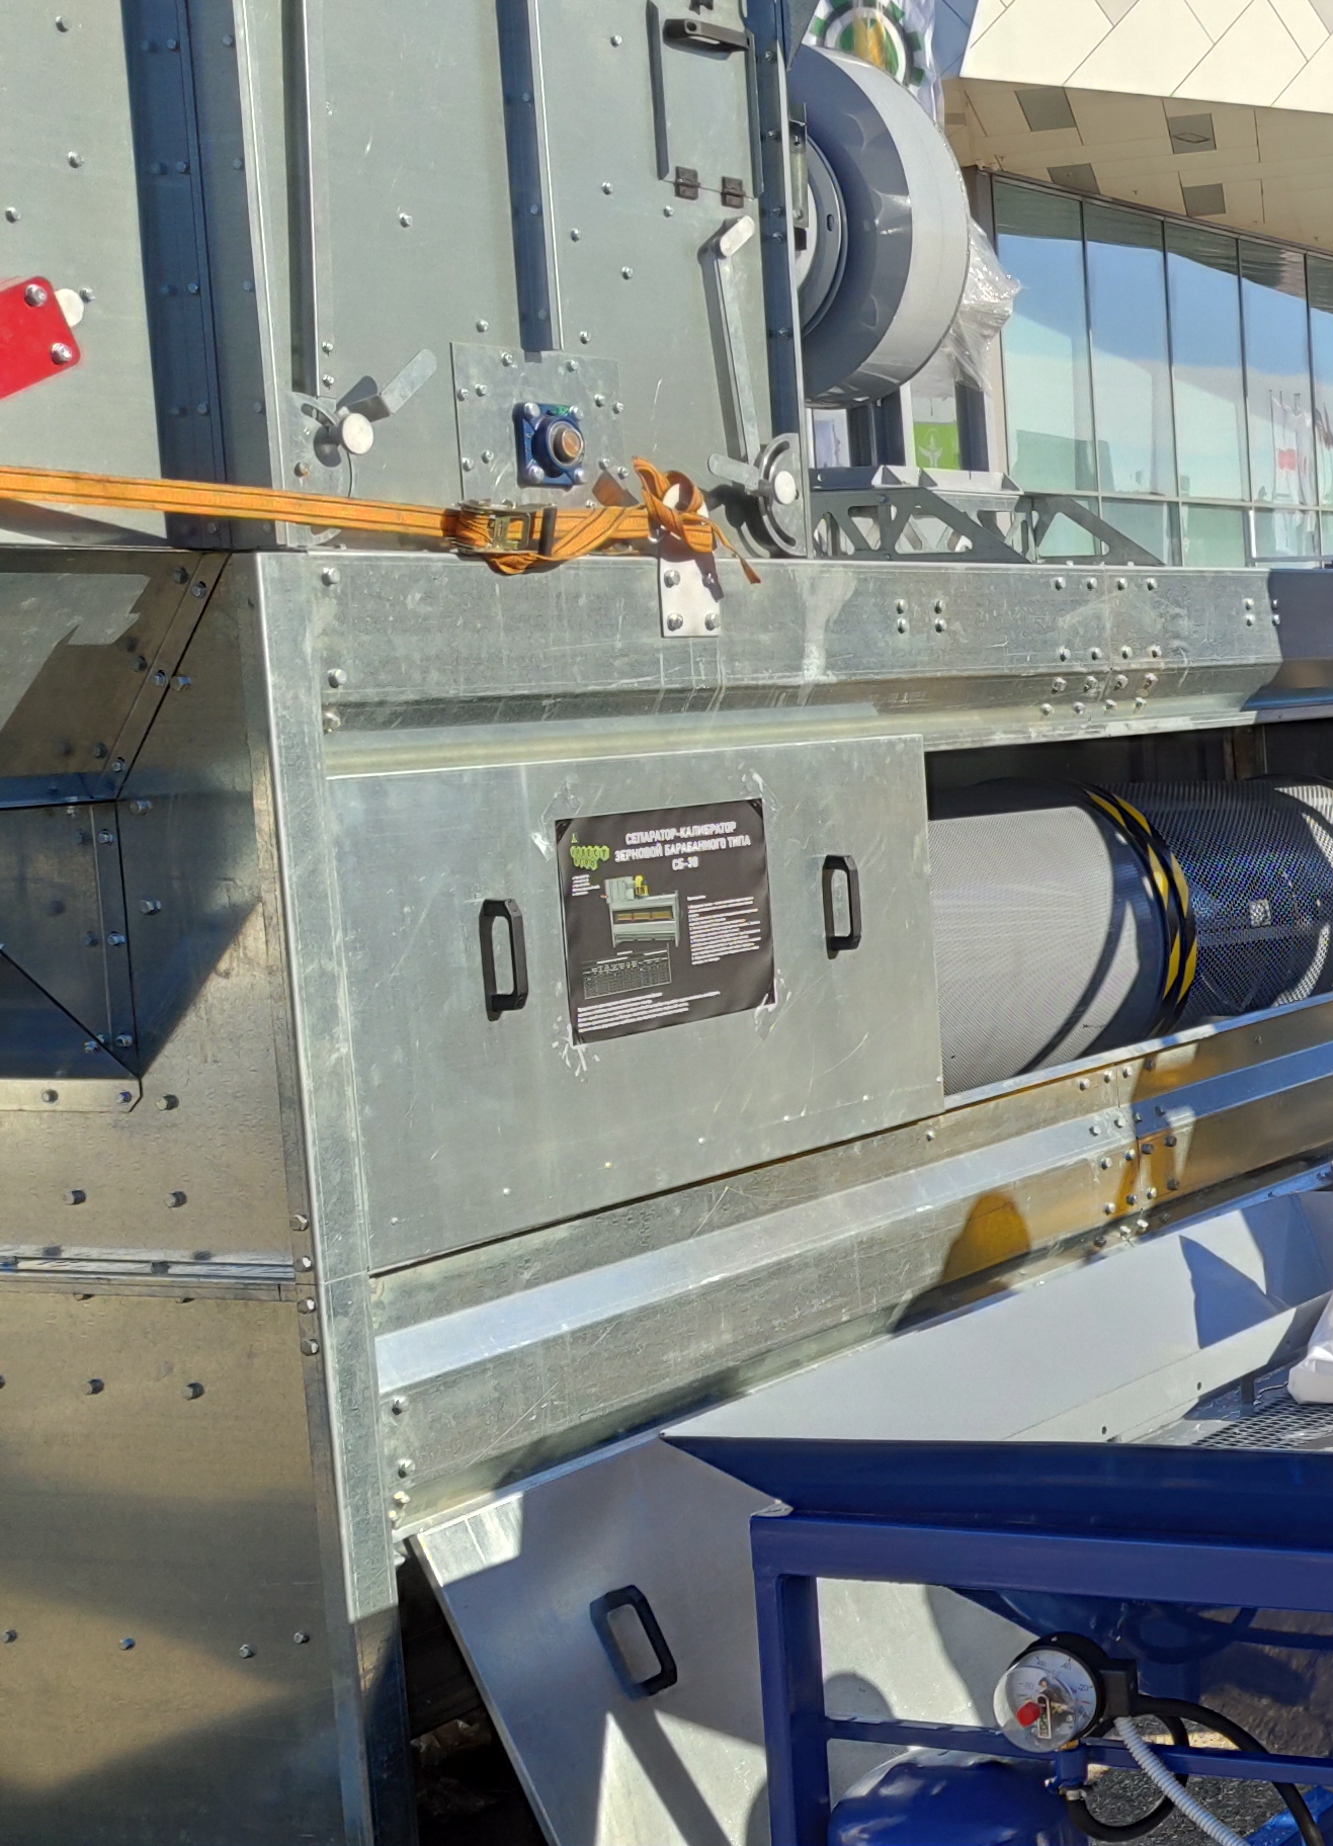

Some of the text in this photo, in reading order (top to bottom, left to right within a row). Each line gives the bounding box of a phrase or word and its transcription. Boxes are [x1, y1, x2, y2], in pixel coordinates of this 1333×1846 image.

[625, 821, 737, 846] СЕПАРАТОР-КАЛИБРАТОР
[614, 841, 663, 863] ЗЕРНОВОЙ
[664, 837, 727, 857] БАРАБАННОГО
[728, 834, 752, 847] ТИПА
